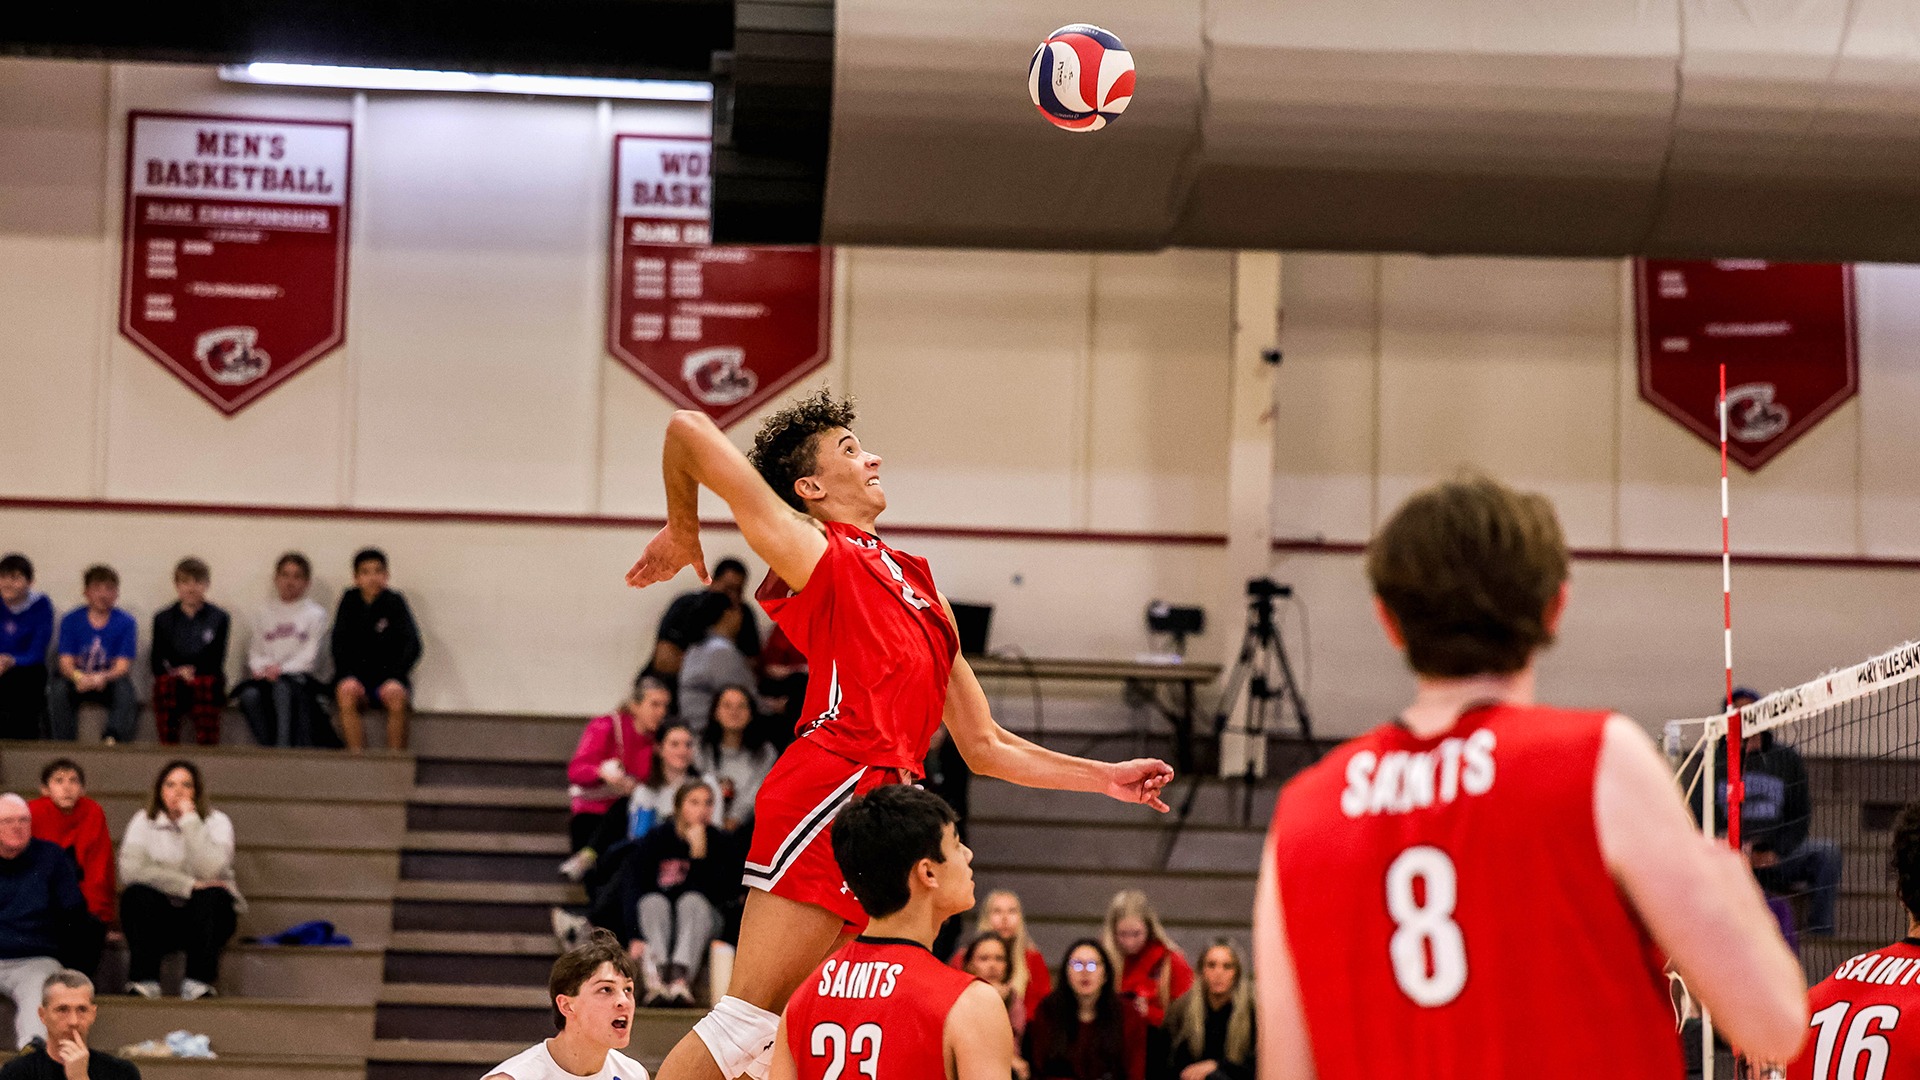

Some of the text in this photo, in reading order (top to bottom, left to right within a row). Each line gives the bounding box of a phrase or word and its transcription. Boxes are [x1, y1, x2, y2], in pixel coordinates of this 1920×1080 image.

[195, 129, 286, 160] MEN'S
[660, 152, 709, 177] WO
[145, 158, 333, 194] BASKETBALL
[1340, 728, 1497, 818] SAINTS
[1385, 844, 1469, 1009] 8
[818, 959, 904, 999] SAINTS
[1835, 953, 1920, 986] SAINT
[811, 1021, 883, 1080] 23
[1810, 1001, 1900, 1080] 16
